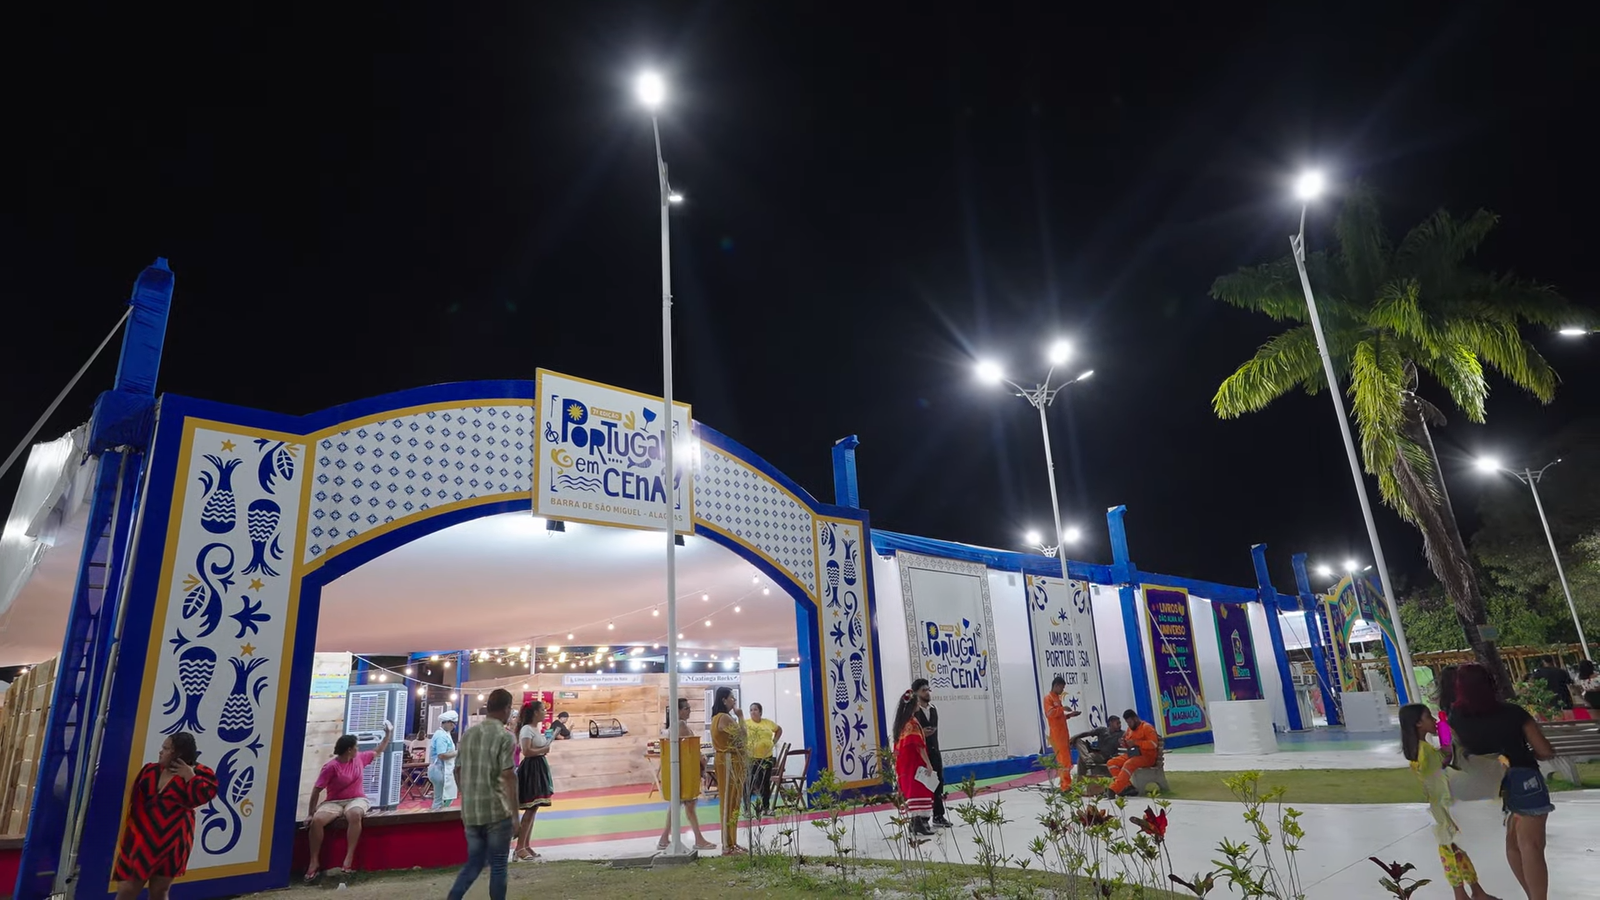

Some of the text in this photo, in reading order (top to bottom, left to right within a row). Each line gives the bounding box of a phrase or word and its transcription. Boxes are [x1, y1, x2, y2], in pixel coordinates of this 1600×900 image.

[575, 457, 600, 475] em
[550, 497, 580, 508] BARRA
[582, 502, 593, 510] DE
[595, 502, 611, 512] SÃO
[613, 506, 641, 516] MIGUEL
[1159, 602, 1179, 614] LIVROS
[1159, 624, 1186, 636] UNIVERSO
[1049, 631, 1063, 646] UMA
[937, 663, 949, 675] em
